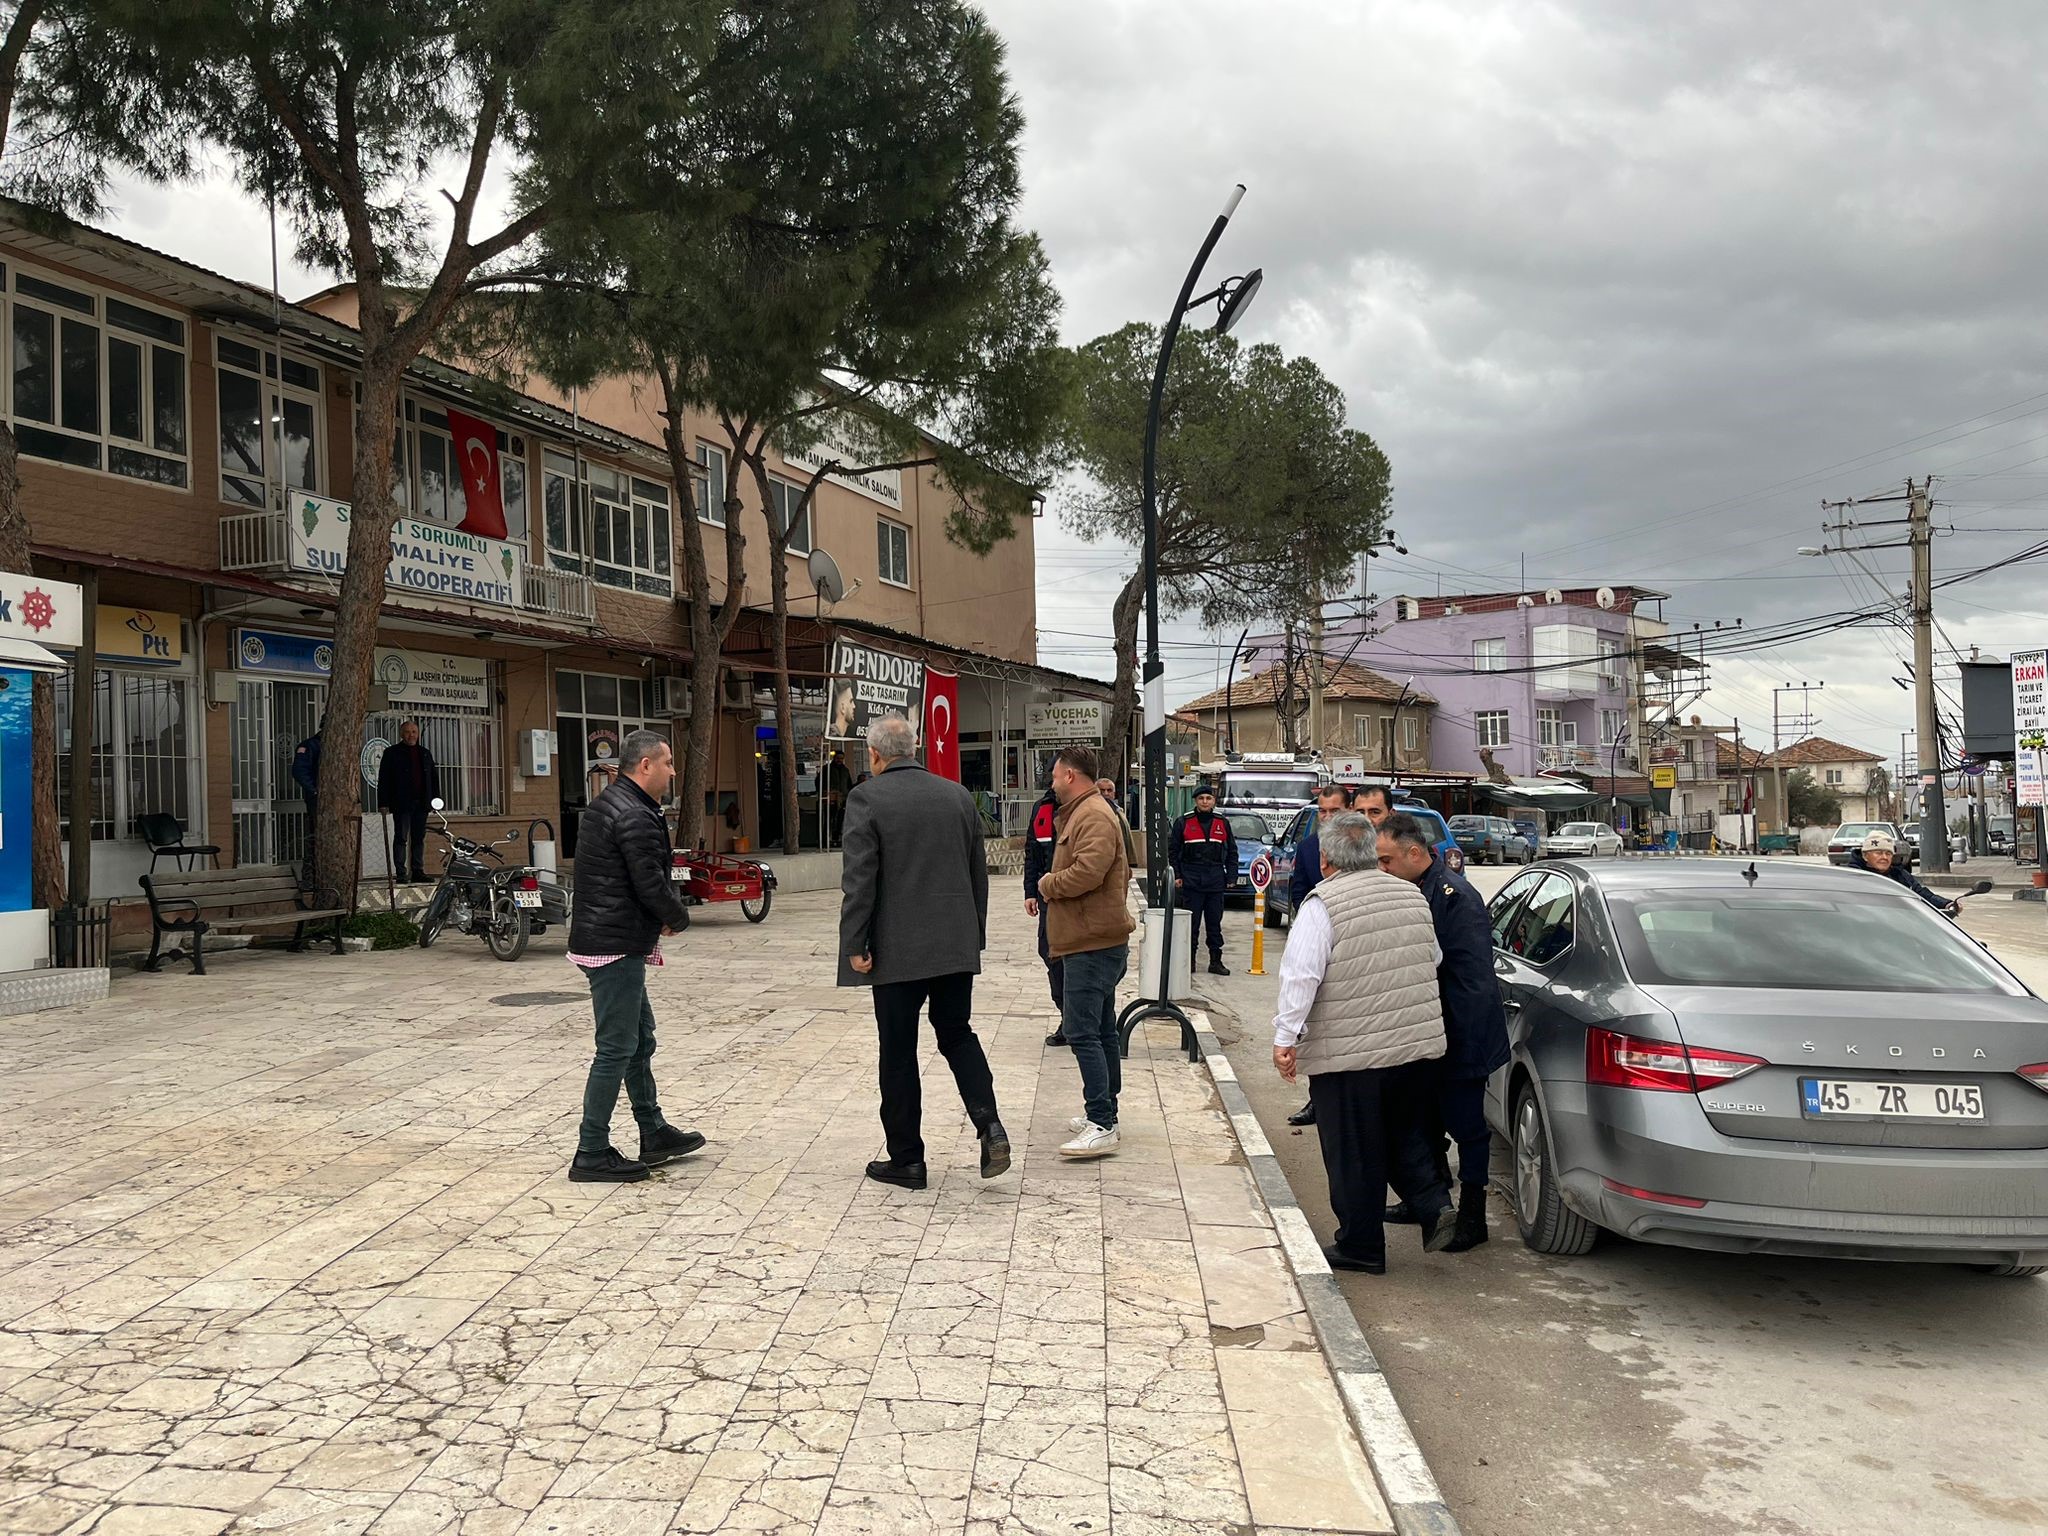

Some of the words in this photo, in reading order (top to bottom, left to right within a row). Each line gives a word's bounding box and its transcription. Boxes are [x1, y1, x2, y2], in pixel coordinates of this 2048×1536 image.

[871, 480, 897, 501] SALONU
[411, 524, 487, 554] SORUMLU
[390, 541, 475, 572] MALİYE
[401, 566, 513, 602] KOOPERATİFİ
[143, 633, 169, 656] Ptt
[839, 646, 922, 688] PENDORE
[2015, 665, 2044, 681] ERKAN
[413, 670, 442, 684] ALAŞEHİR
[421, 686, 445, 698] KORUMA
[446, 687, 479, 701] BAŞKANLIĞI
[860, 684, 875, 701] SAÇ
[876, 687, 906, 703] TASARIM
[2017, 684, 2035, 693] TARIM
[2035, 683, 2043, 691] VE
[2019, 694, 2042, 704] TİCARET
[867, 703, 884, 715] Kids
[1044, 706, 1099, 720] YÜCEHAS
[2033, 705, 2046, 717] İLAÇ
[1802, 1041, 1986, 1058] ŠKODA
[1707, 1101, 1766, 1112] SUPERB
[1807, 1098, 1819, 1106] TR
[1821, 1084, 1850, 1110] 45
[1877, 1085, 1908, 1113] ZR
[1934, 1087, 1981, 1115] 045
